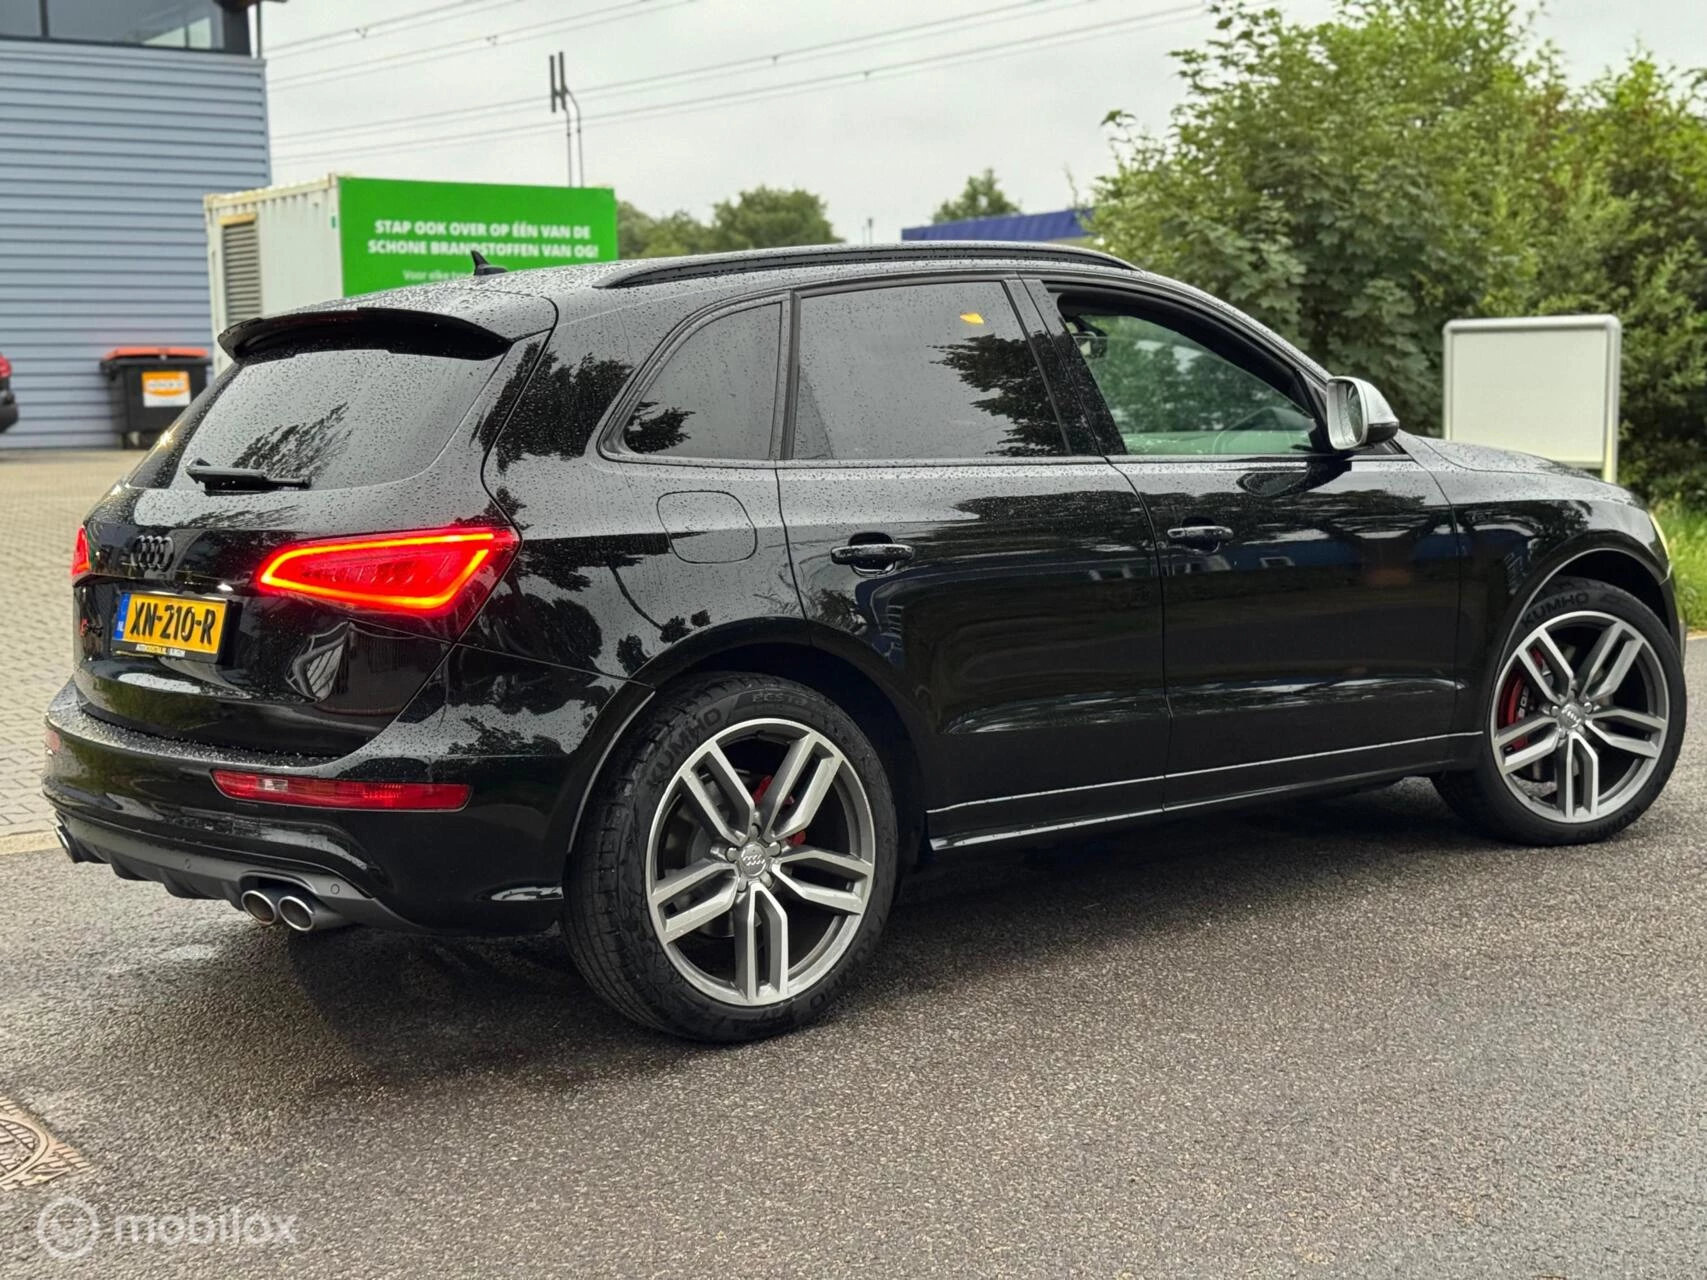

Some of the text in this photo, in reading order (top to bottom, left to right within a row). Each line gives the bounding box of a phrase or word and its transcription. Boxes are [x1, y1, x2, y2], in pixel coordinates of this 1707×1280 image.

[374, 219, 592, 239] STAP OOK OVER OP ÉÉN VAN DE
[367, 239, 427, 254] SCHONE
[430, 241, 539, 257] BRANDSTOFFEN
[541, 243, 572, 258] VAN
[129, 600, 217, 645] XN-210-R
[1521, 591, 1590, 628] KUMHO
